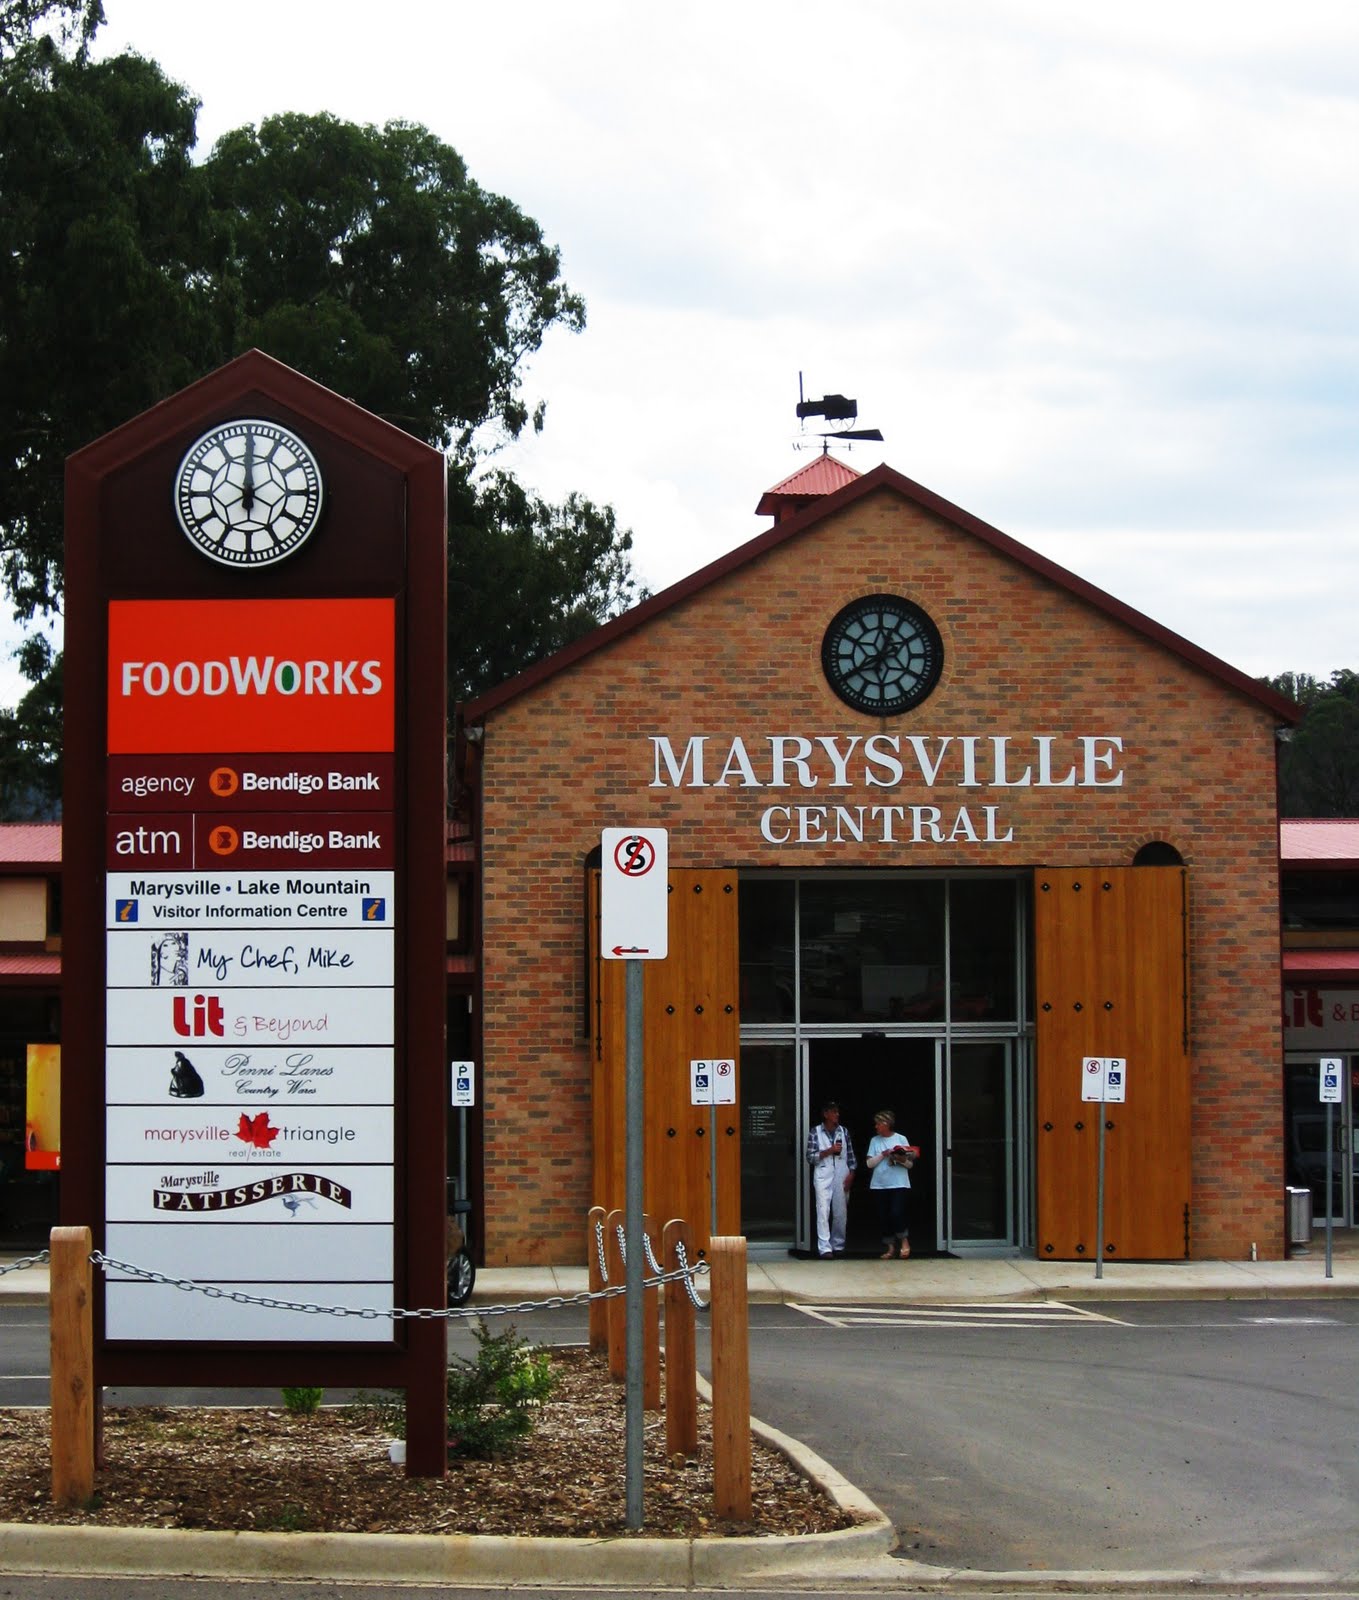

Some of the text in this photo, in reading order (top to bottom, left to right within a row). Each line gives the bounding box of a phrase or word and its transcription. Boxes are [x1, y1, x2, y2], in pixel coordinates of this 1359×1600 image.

[121, 656, 383, 696] FOODWORKS
[648, 735, 1125, 789] MARYSVILLE
[121, 776, 195, 797] agency
[242, 772, 324, 795] Bendigo
[327, 772, 380, 790] Bank
[759, 805, 1014, 844] CENTRAL
[115, 826, 181, 854] atm
[242, 830, 325, 853] Bendigo
[328, 830, 381, 849] Bank
[130, 879, 370, 899] Marysville Lake Mountain
[152, 903, 348, 918] Visitor Information Centre
[196, 944, 354, 981] My Chef, Mike
[172, 994, 225, 1037] Lit
[252, 1014, 328, 1040] Beyond
[1332, 1003, 1347, 1022] &
[220, 1053, 334, 1076] Penni Lanes
[459, 1066, 468, 1076] P
[697, 1062, 706, 1073] P
[1111, 1060, 1120, 1071] P
[1327, 1063, 1335, 1073] P
[235, 1079, 317, 1098] Country Wares
[144, 1126, 355, 1144] marysville triangle
[228, 1150, 282, 1158] real estate
[160, 1171, 220, 1188] Marysville
[157, 1174, 343, 1210] PATISSERIE
